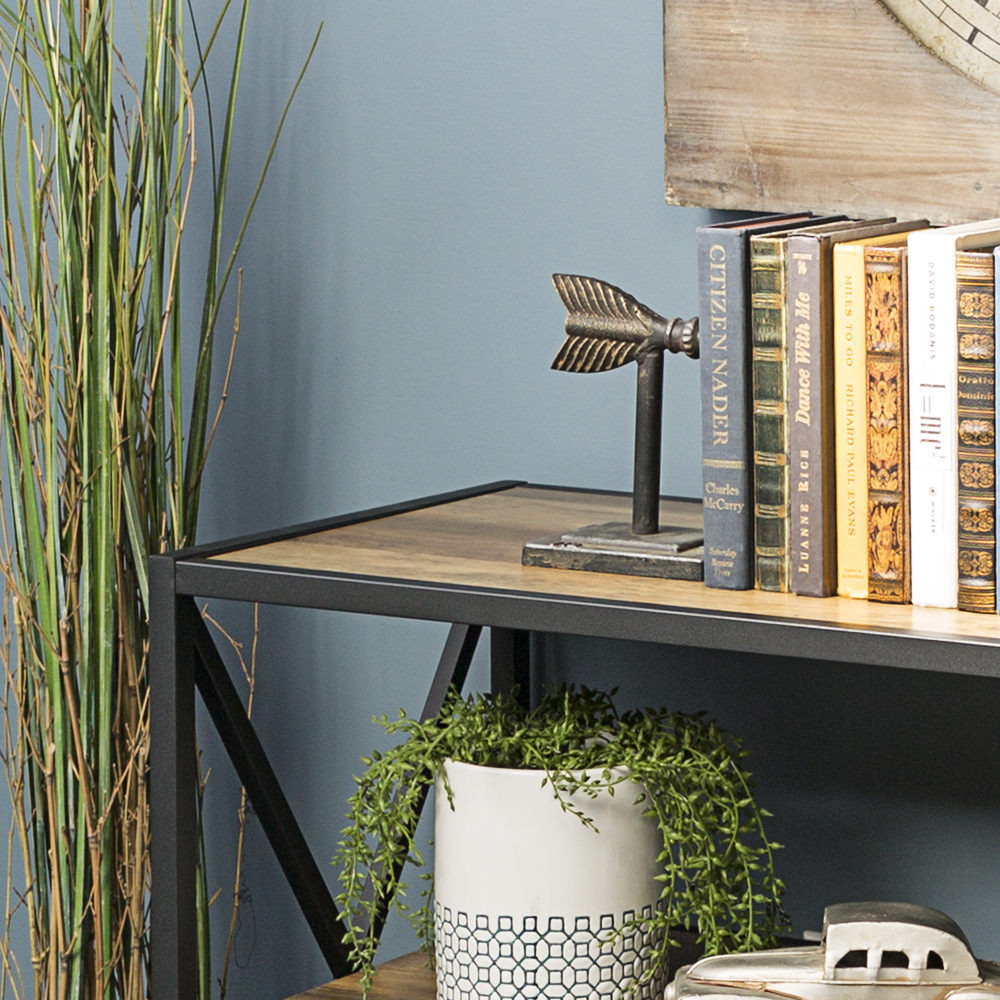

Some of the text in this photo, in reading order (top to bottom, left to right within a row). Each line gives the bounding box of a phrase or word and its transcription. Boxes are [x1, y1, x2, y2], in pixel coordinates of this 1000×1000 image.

[708, 244, 729, 446] CITIZEN NADER
[794, 291, 811, 427] Dance With Me
[844, 275, 854, 367] MILES TO GO
[928, 261, 937, 361] DAVID BODANIS
[703, 496, 745, 514] McCarry
[705, 482, 740, 496] Charles
[797, 448, 811, 574] LUANNE RICE
[845, 384, 857, 537] RICHARD PAUL EVANS
